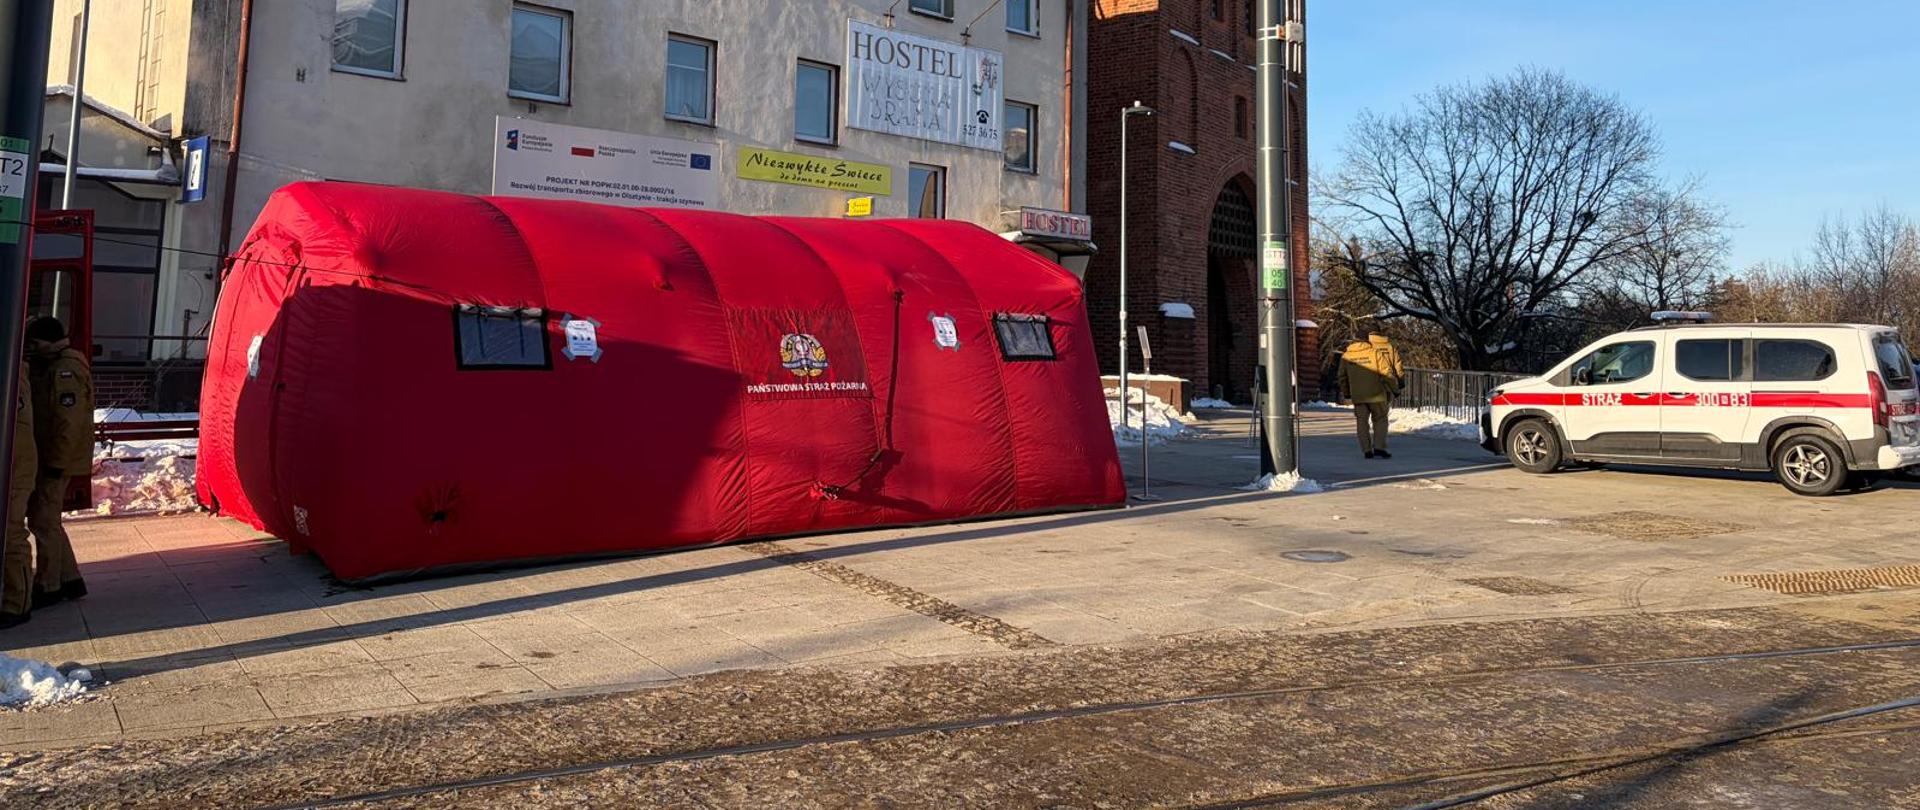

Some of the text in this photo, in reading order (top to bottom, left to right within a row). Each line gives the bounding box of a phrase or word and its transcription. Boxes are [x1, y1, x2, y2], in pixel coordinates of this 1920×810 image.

[853, 31, 962, 79] HOSTEL
[746, 152, 883, 182] Niezwykłe Świece
[545, 176, 578, 185] PROJEKT
[580, 179, 590, 187] NR
[780, 172, 789, 180] do
[791, 173, 813, 184] domu
[510, 181, 536, 192] Rozwój
[537, 184, 574, 194] transportu
[575, 187, 614, 198] zbiorowego
[621, 191, 652, 201] Olsztynie
[1023, 211, 1089, 236] HOSTEL
[747, 381, 868, 394] PAŃSTWOWA STRAŻ POŻARNA
[1582, 392, 1623, 406] STRAŻ
[1695, 392, 1720, 406] 300
[1730, 392, 1748, 406] 83
